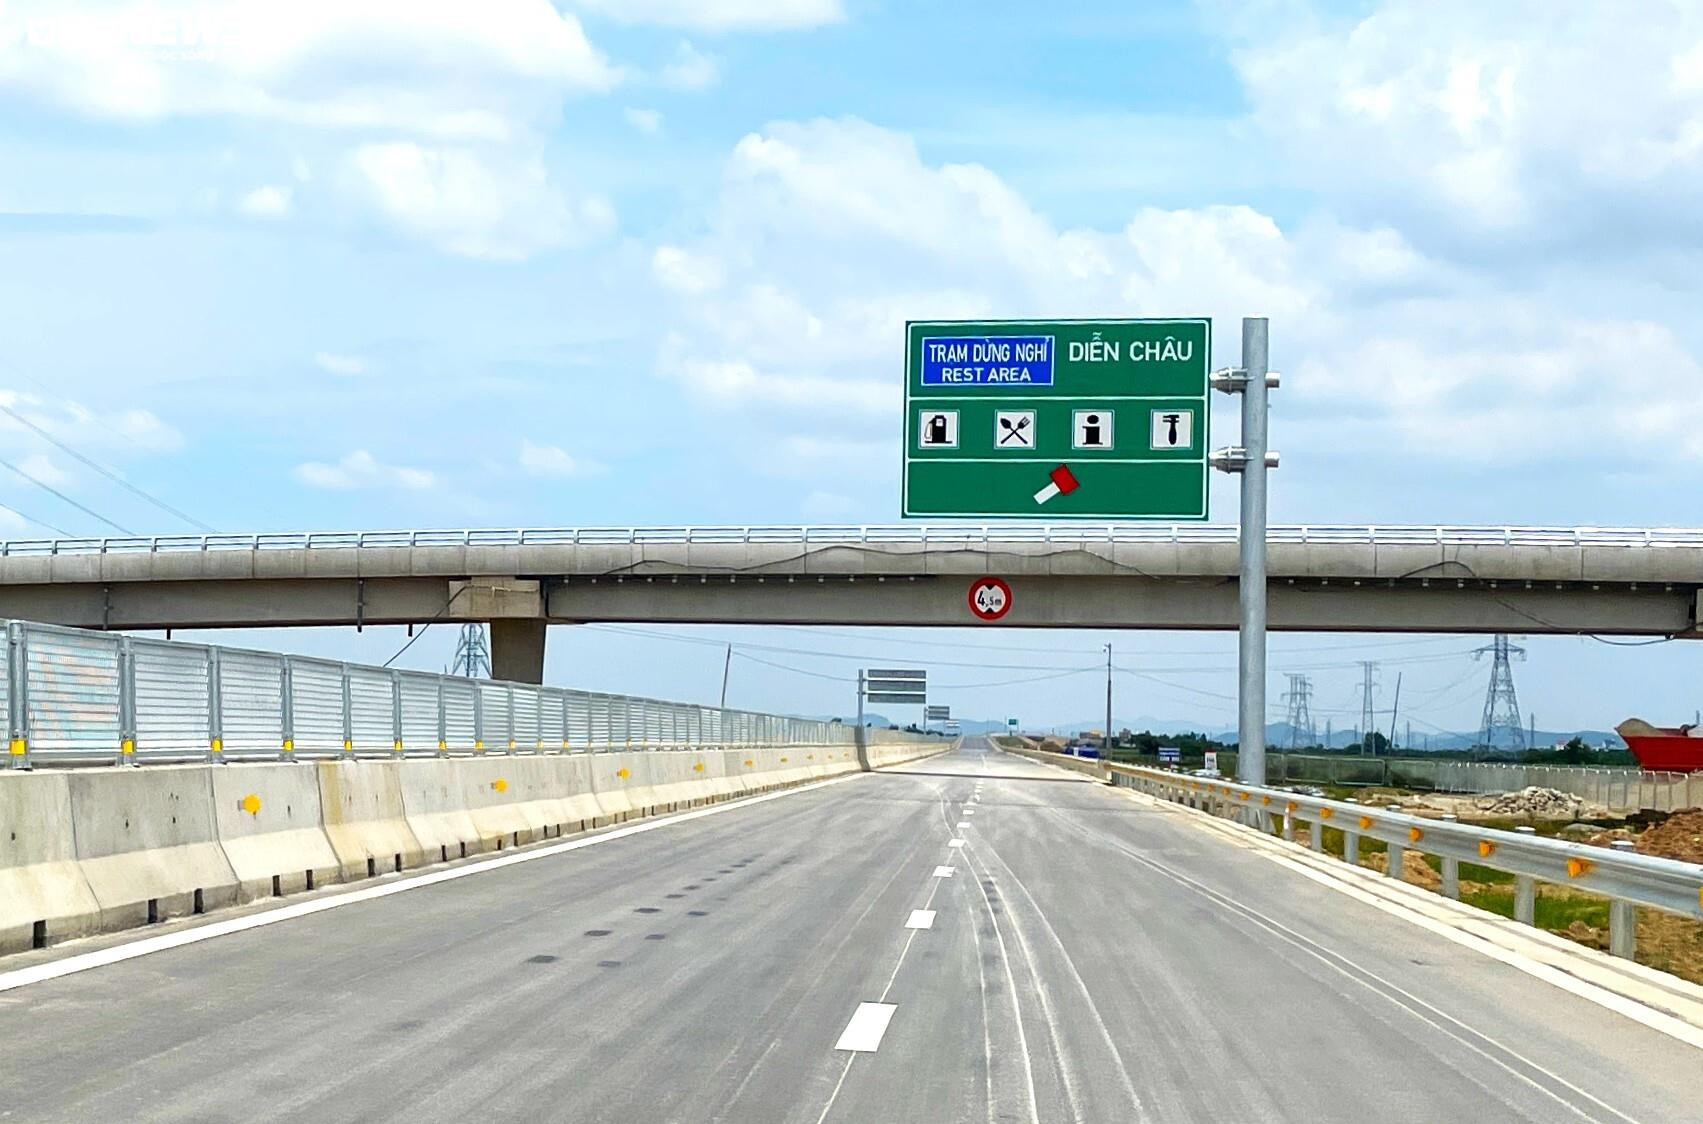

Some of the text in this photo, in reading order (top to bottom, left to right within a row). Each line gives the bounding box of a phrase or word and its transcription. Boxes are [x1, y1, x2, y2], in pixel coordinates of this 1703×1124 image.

[1069, 332, 1193, 362] DIỄN CHÂU
[942, 367, 1032, 382] REST AREA
